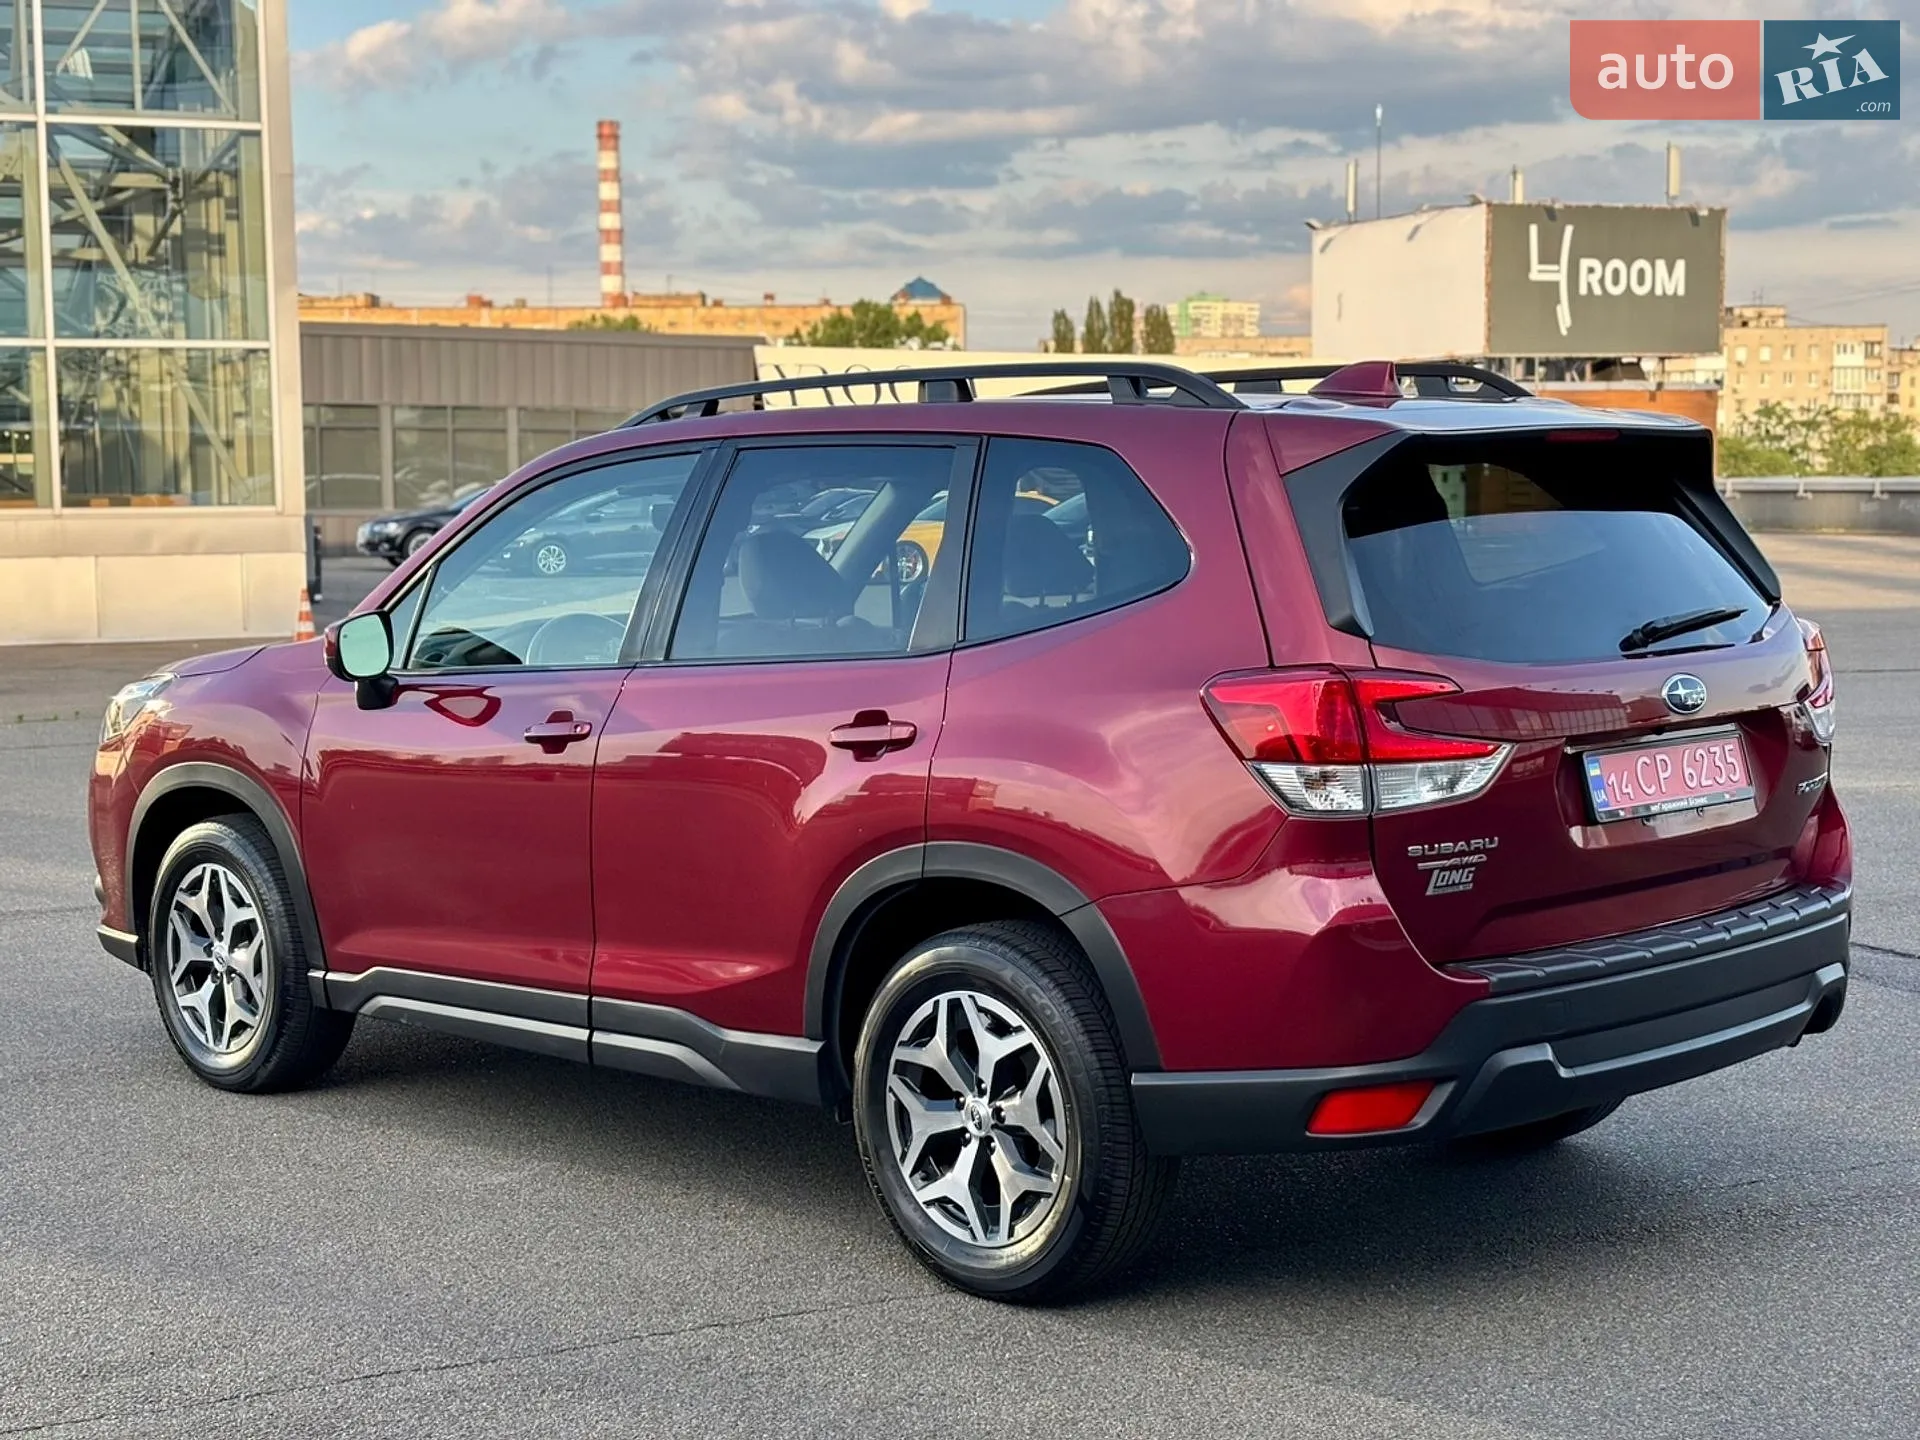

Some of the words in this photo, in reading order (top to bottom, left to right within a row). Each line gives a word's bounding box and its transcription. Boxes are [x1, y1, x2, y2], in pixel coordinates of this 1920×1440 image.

[1578, 257, 1687, 297] ROOM
[1607, 769, 1636, 803] 14
[1635, 753, 1672, 796] CP
[1682, 743, 1742, 790] 6235
[1593, 788, 1609, 803] UA
[1407, 836, 1500, 857] SUBARU
[1425, 867, 1476, 896] LONG
